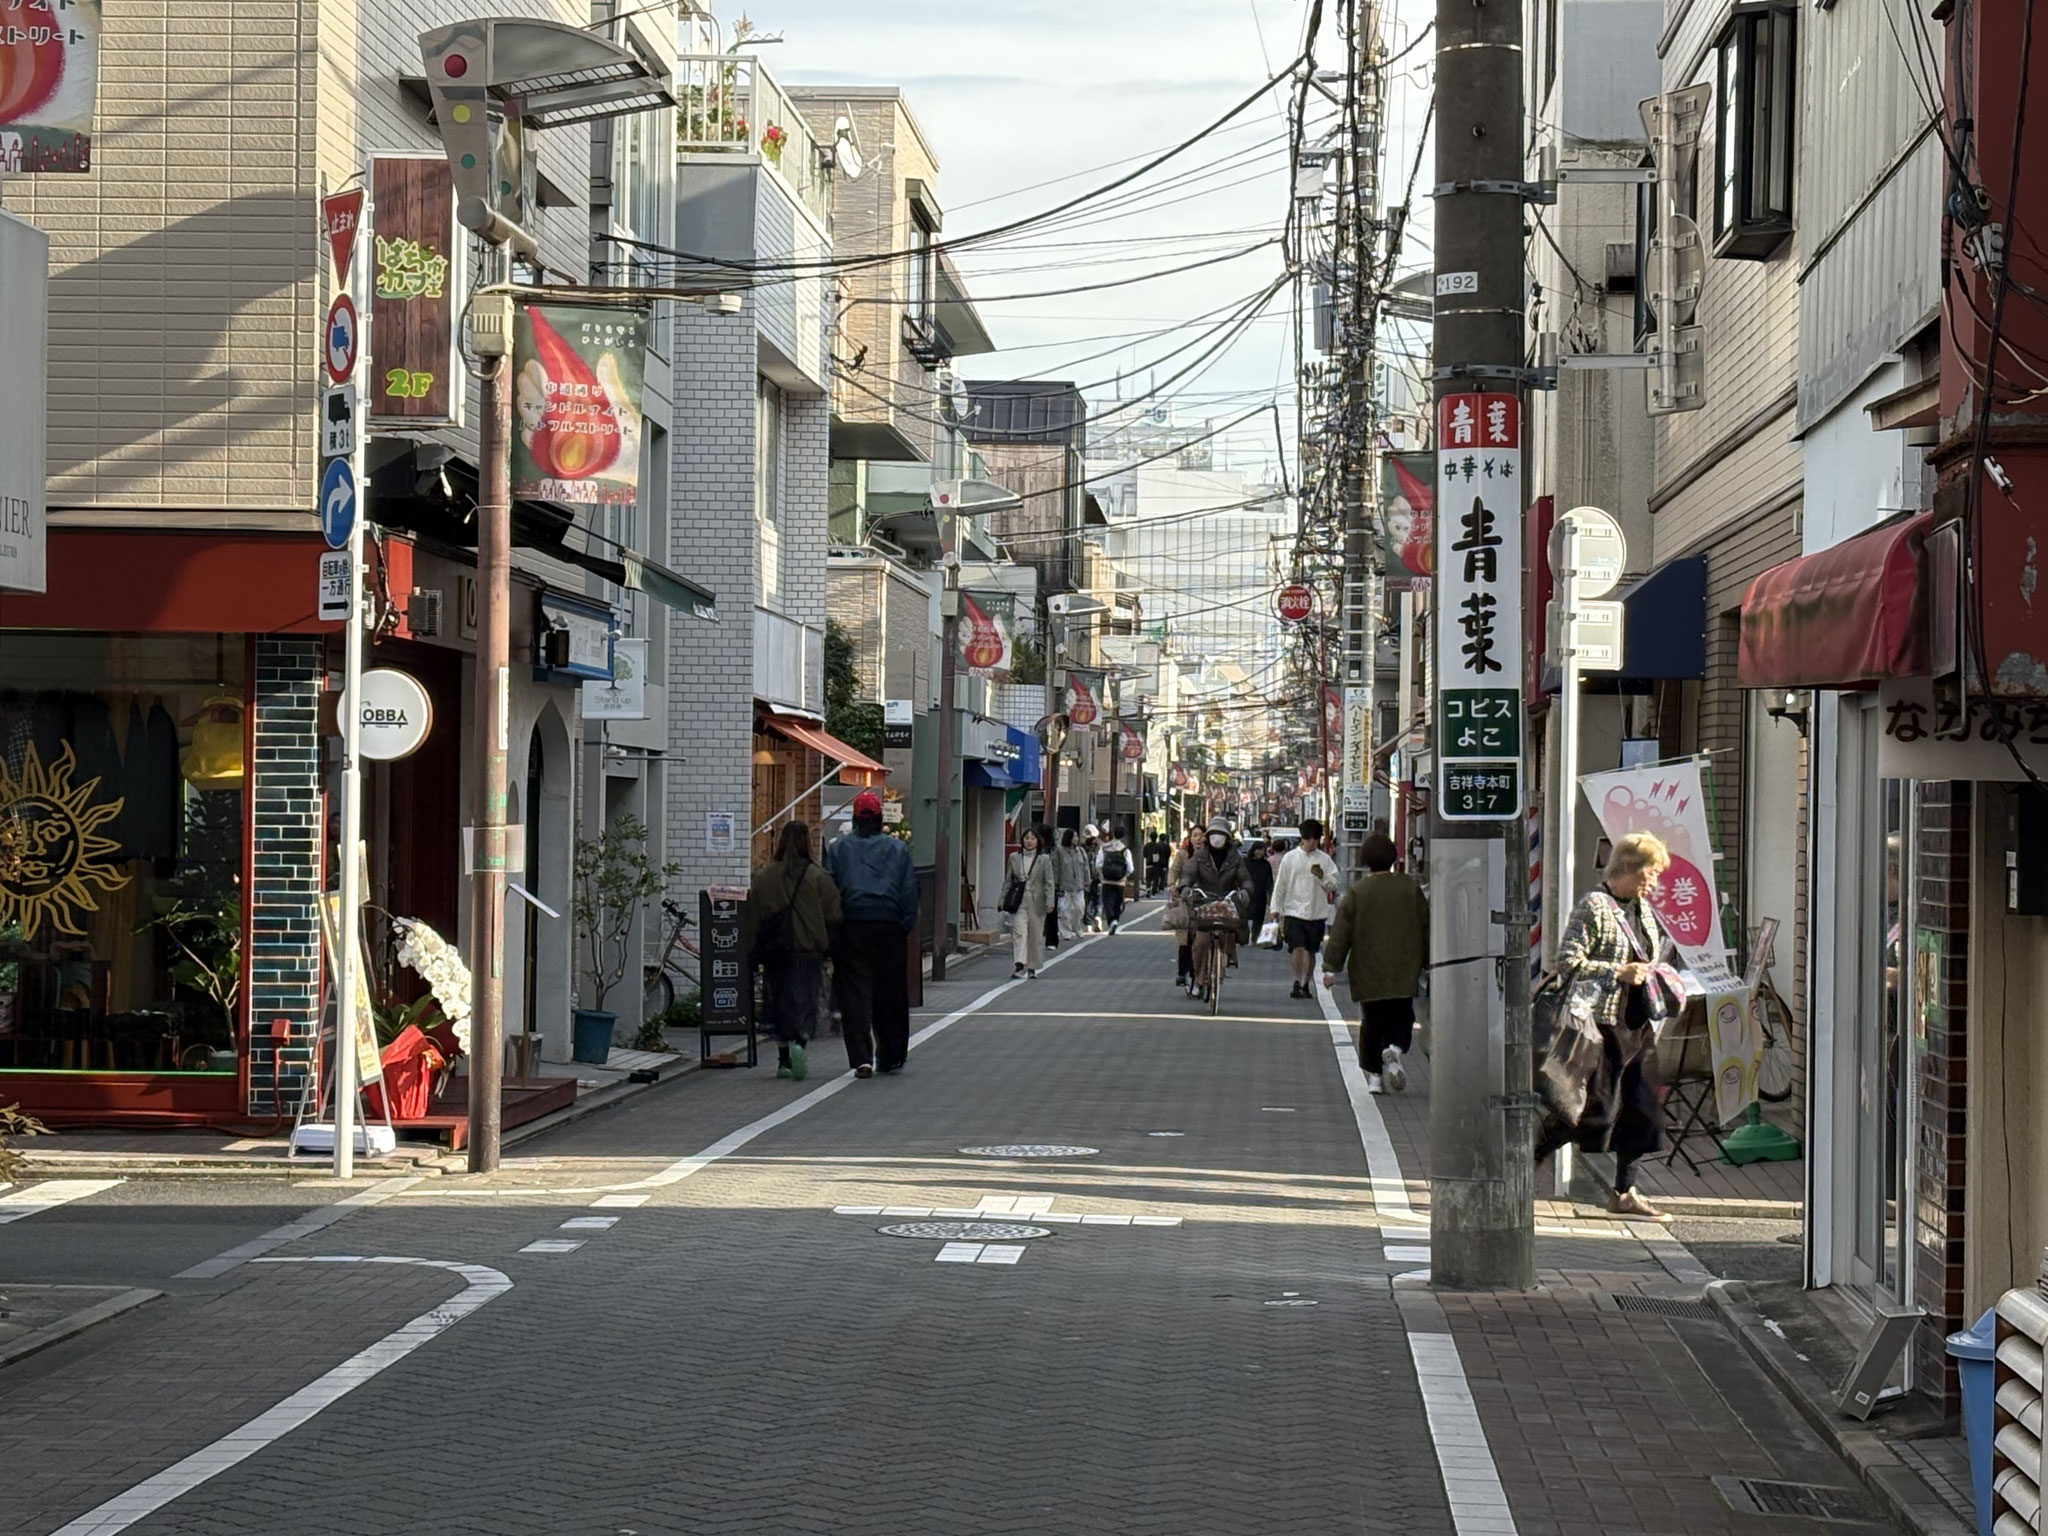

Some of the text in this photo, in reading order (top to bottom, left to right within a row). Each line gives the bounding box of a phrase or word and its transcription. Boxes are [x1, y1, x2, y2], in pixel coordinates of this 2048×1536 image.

[331, 210, 354, 234] 止まれ
[1445, 275, 1475, 290] 192
[386, 368, 433, 398] 2F
[523, 401, 628, 417] キャンドルナイト
[519, 420, 633, 435] ハートフルストリート
[1449, 399, 1509, 443] 青葉
[1445, 455, 1515, 483] 中華そば
[0, 495, 33, 539] IER
[322, 578, 351, 596] 一方通行
[1451, 496, 1503, 674] 青葉
[1280, 595, 1310, 609] 消火栓
[1447, 699, 1512, 718] コピス
[1457, 727, 1501, 747] よこ
[1449, 775, 1511, 791] 吉祥寺本町
[1462, 795, 1497, 809] 3-7
